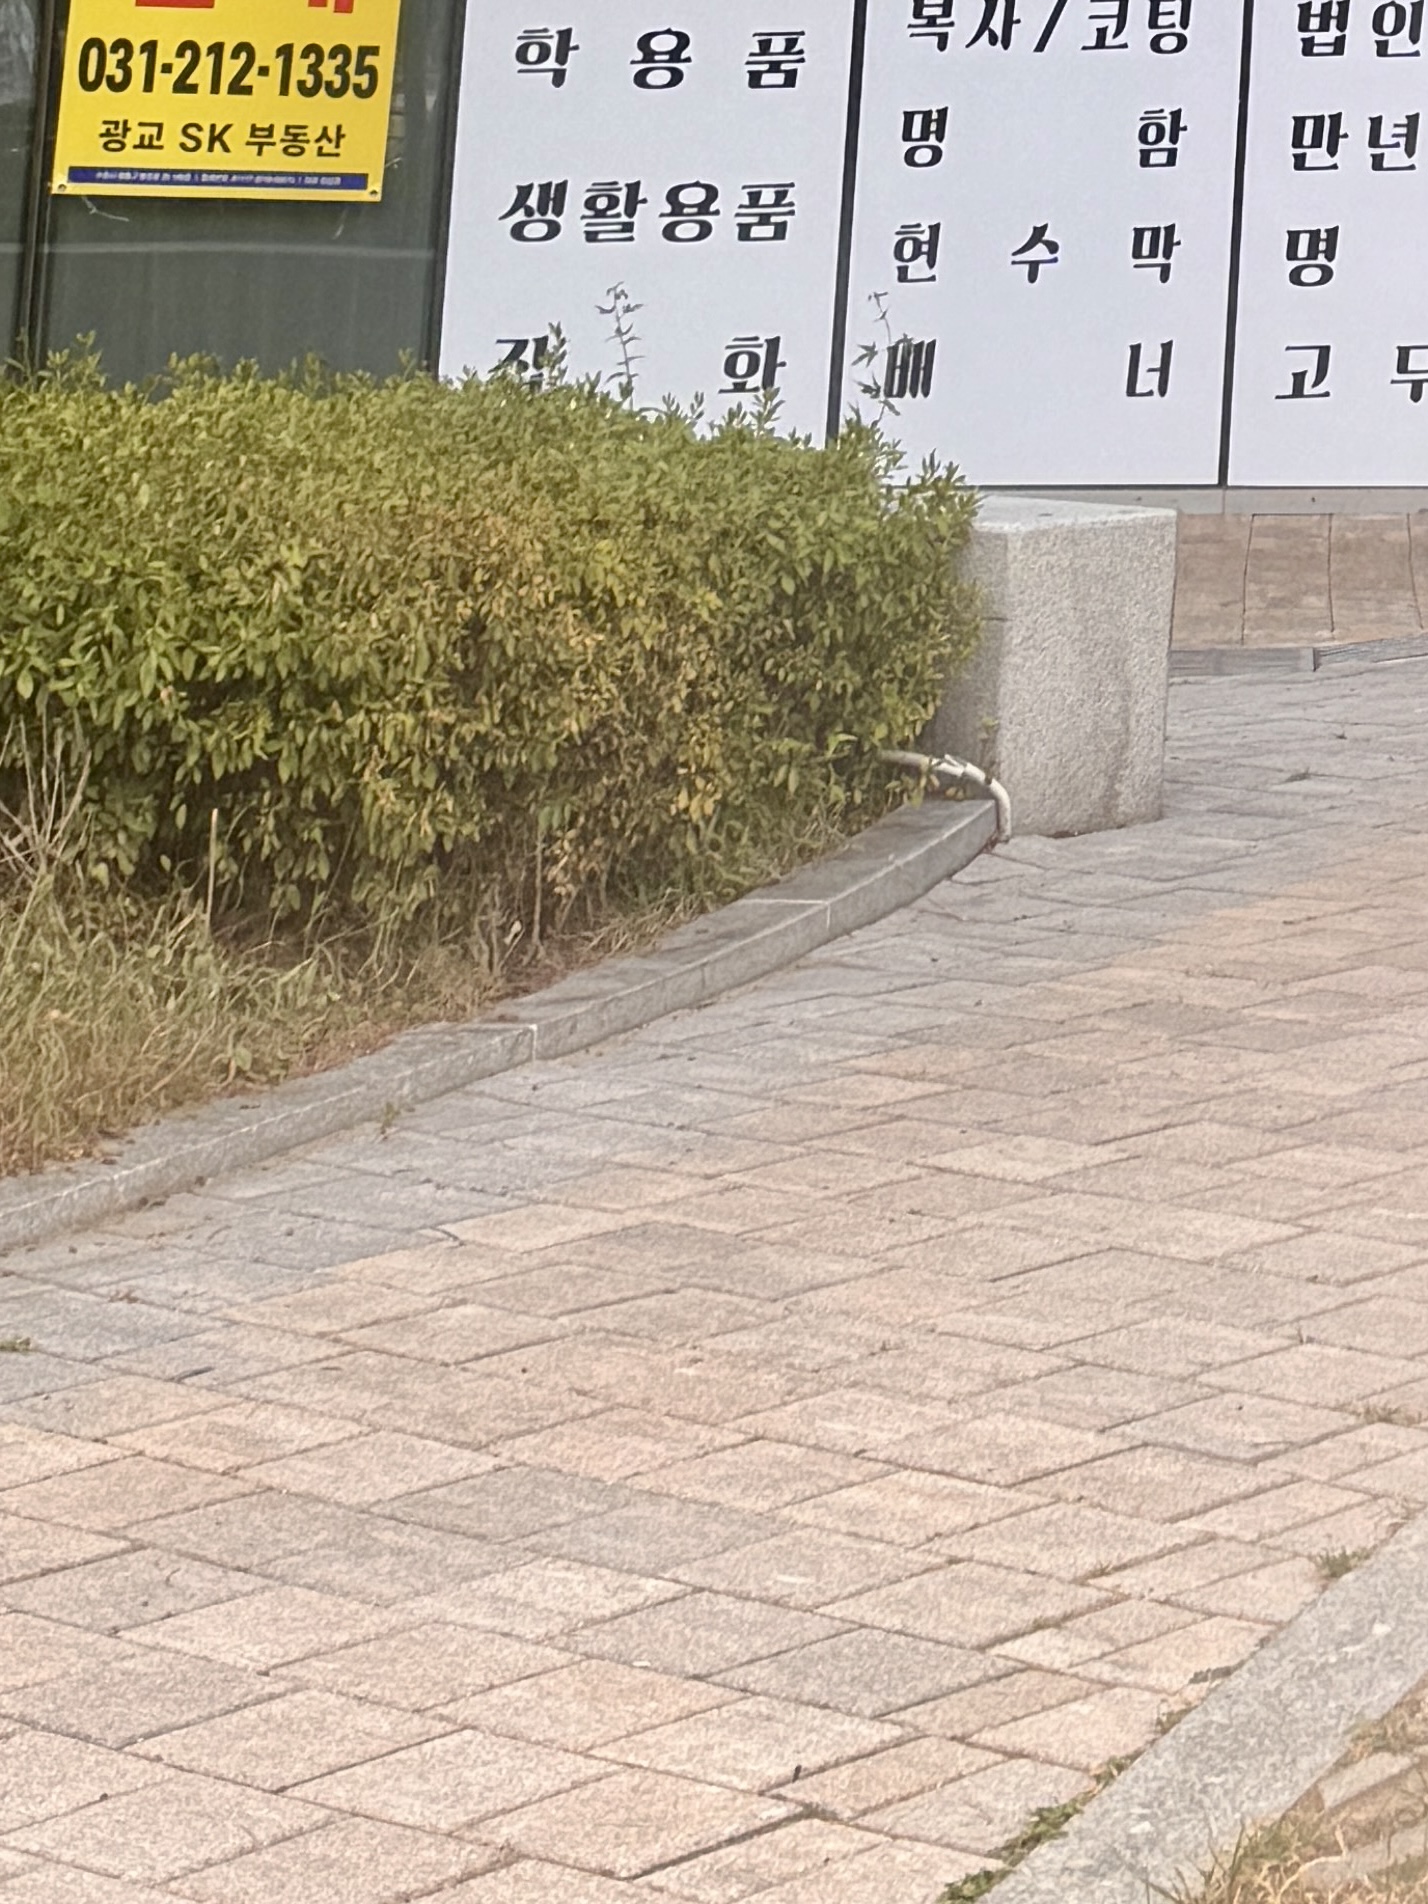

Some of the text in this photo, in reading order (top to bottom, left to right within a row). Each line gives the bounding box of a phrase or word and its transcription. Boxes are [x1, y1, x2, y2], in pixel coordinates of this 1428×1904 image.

[98, 120, 346, 158] 광교 SK 부동산
[498, 180, 797, 246] 생활용품
